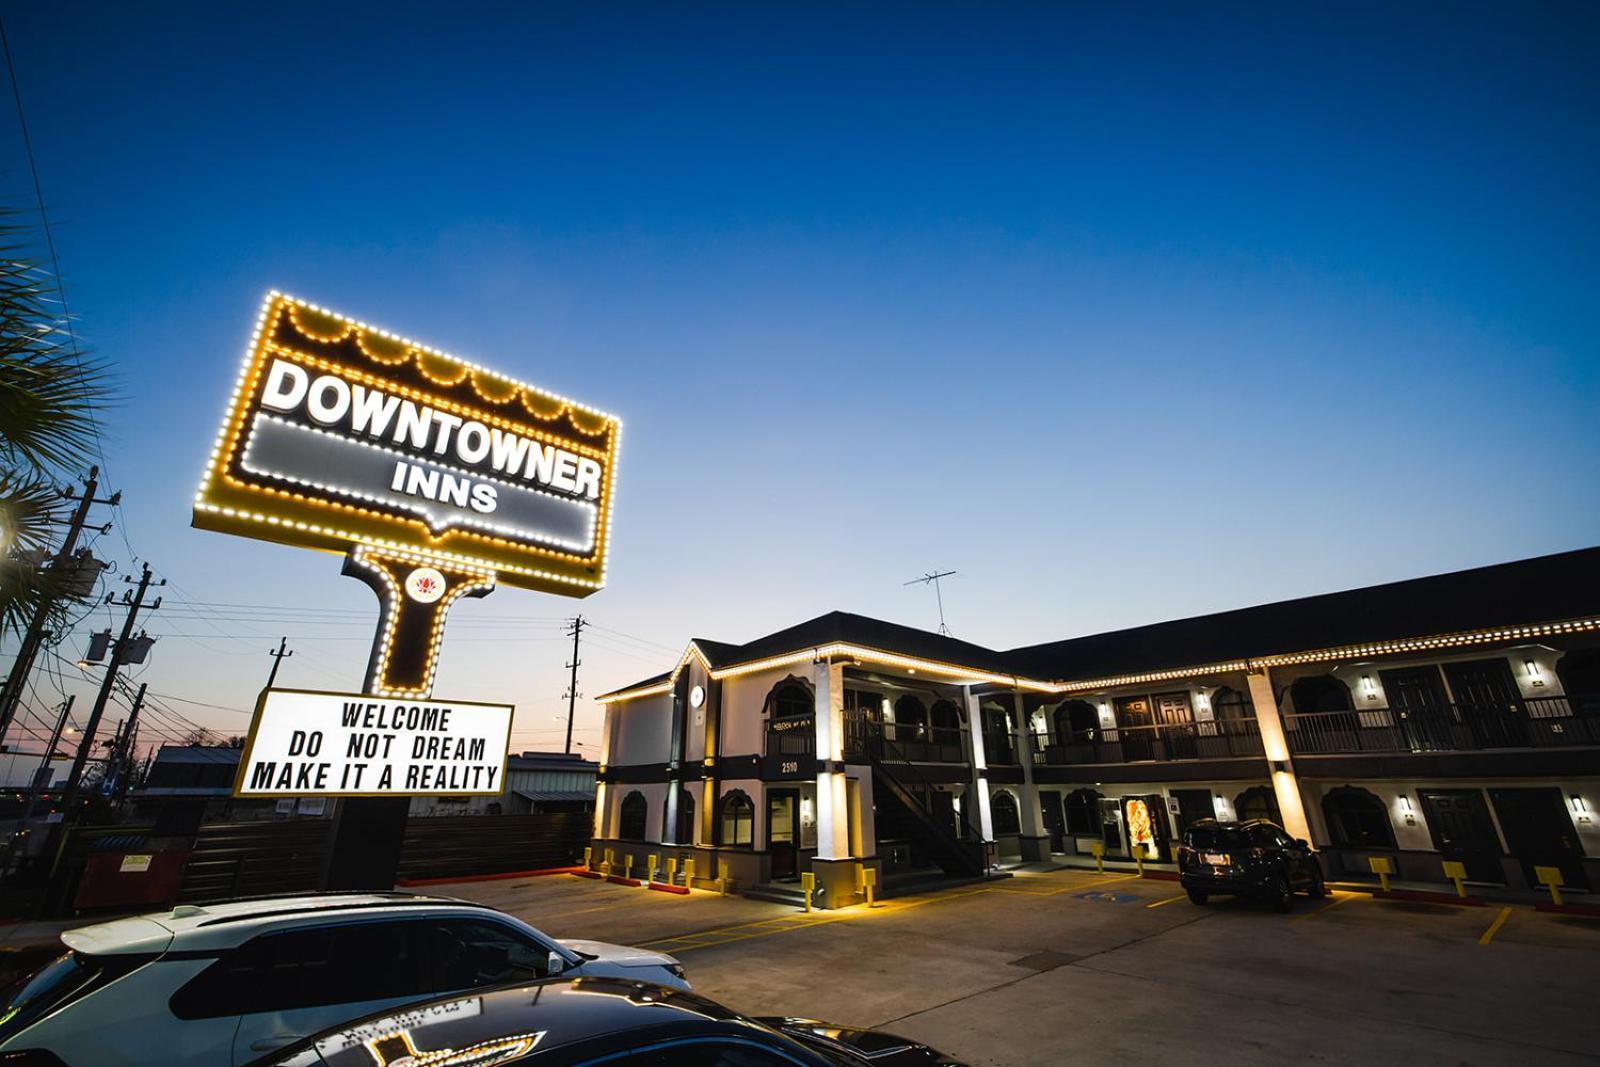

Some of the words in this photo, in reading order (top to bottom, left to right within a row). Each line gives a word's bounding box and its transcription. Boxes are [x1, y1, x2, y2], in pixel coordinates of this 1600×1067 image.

[261, 359, 601, 499] DOWNTOWNER
[391, 461, 498, 514] INNS
[341, 702, 452, 732] WELCOME
[287, 730, 324, 758] DO
[346, 732, 396, 759] NOT
[411, 735, 486, 761] DREAM
[249, 761, 332, 790] MAKE
[340, 763, 369, 790] IT
[377, 764, 393, 790] A
[405, 764, 498, 790] REALITY
